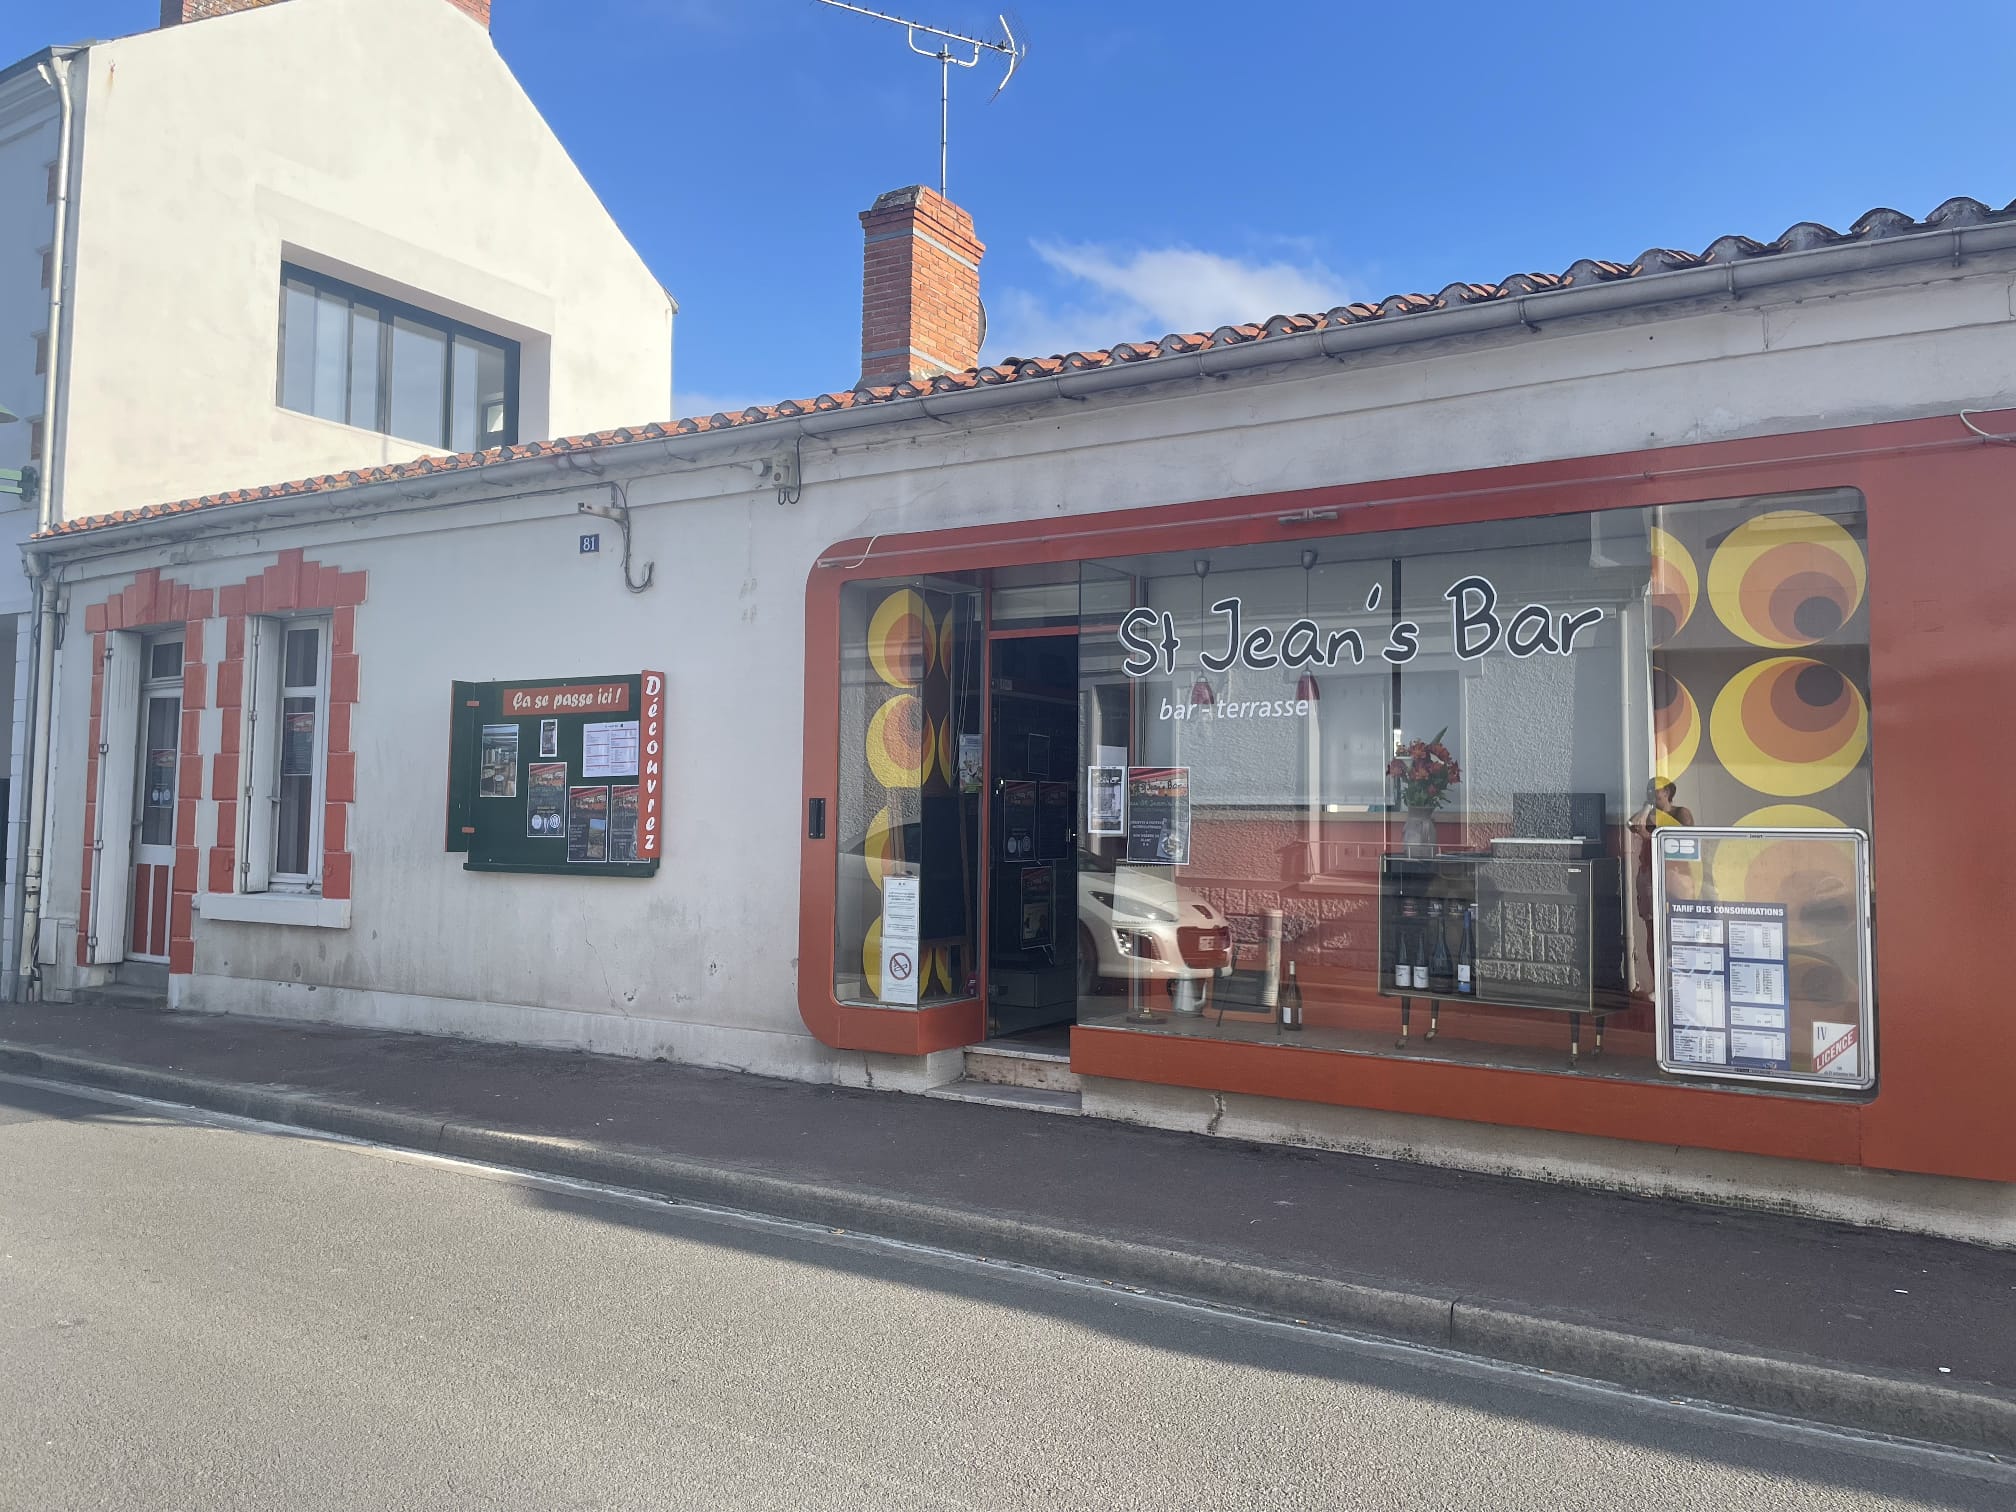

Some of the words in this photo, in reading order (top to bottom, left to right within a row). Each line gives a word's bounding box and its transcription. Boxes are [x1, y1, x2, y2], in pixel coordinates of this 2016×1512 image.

[583, 536, 595, 551] 81
[1119, 607, 1180, 677] St
[1200, 583, 1420, 672] Jean's
[1444, 575, 1604, 660] Bar
[512, 691, 531, 711] Ça
[534, 694, 549, 709] se
[553, 692, 593, 710] passe
[1159, 697, 1197, 721] bar
[1216, 698, 1309, 719] terrasse
[645, 675, 661, 850] Découvrez
[1664, 838, 1695, 854] CB
[1672, 904, 1694, 913] TARIF
[1695, 905, 1712, 914] DES
[1713, 905, 1784, 917] CONSOMMATIONS
[1817, 1026, 1827, 1041] IV
[1816, 1031, 1854, 1070] LICENCE
